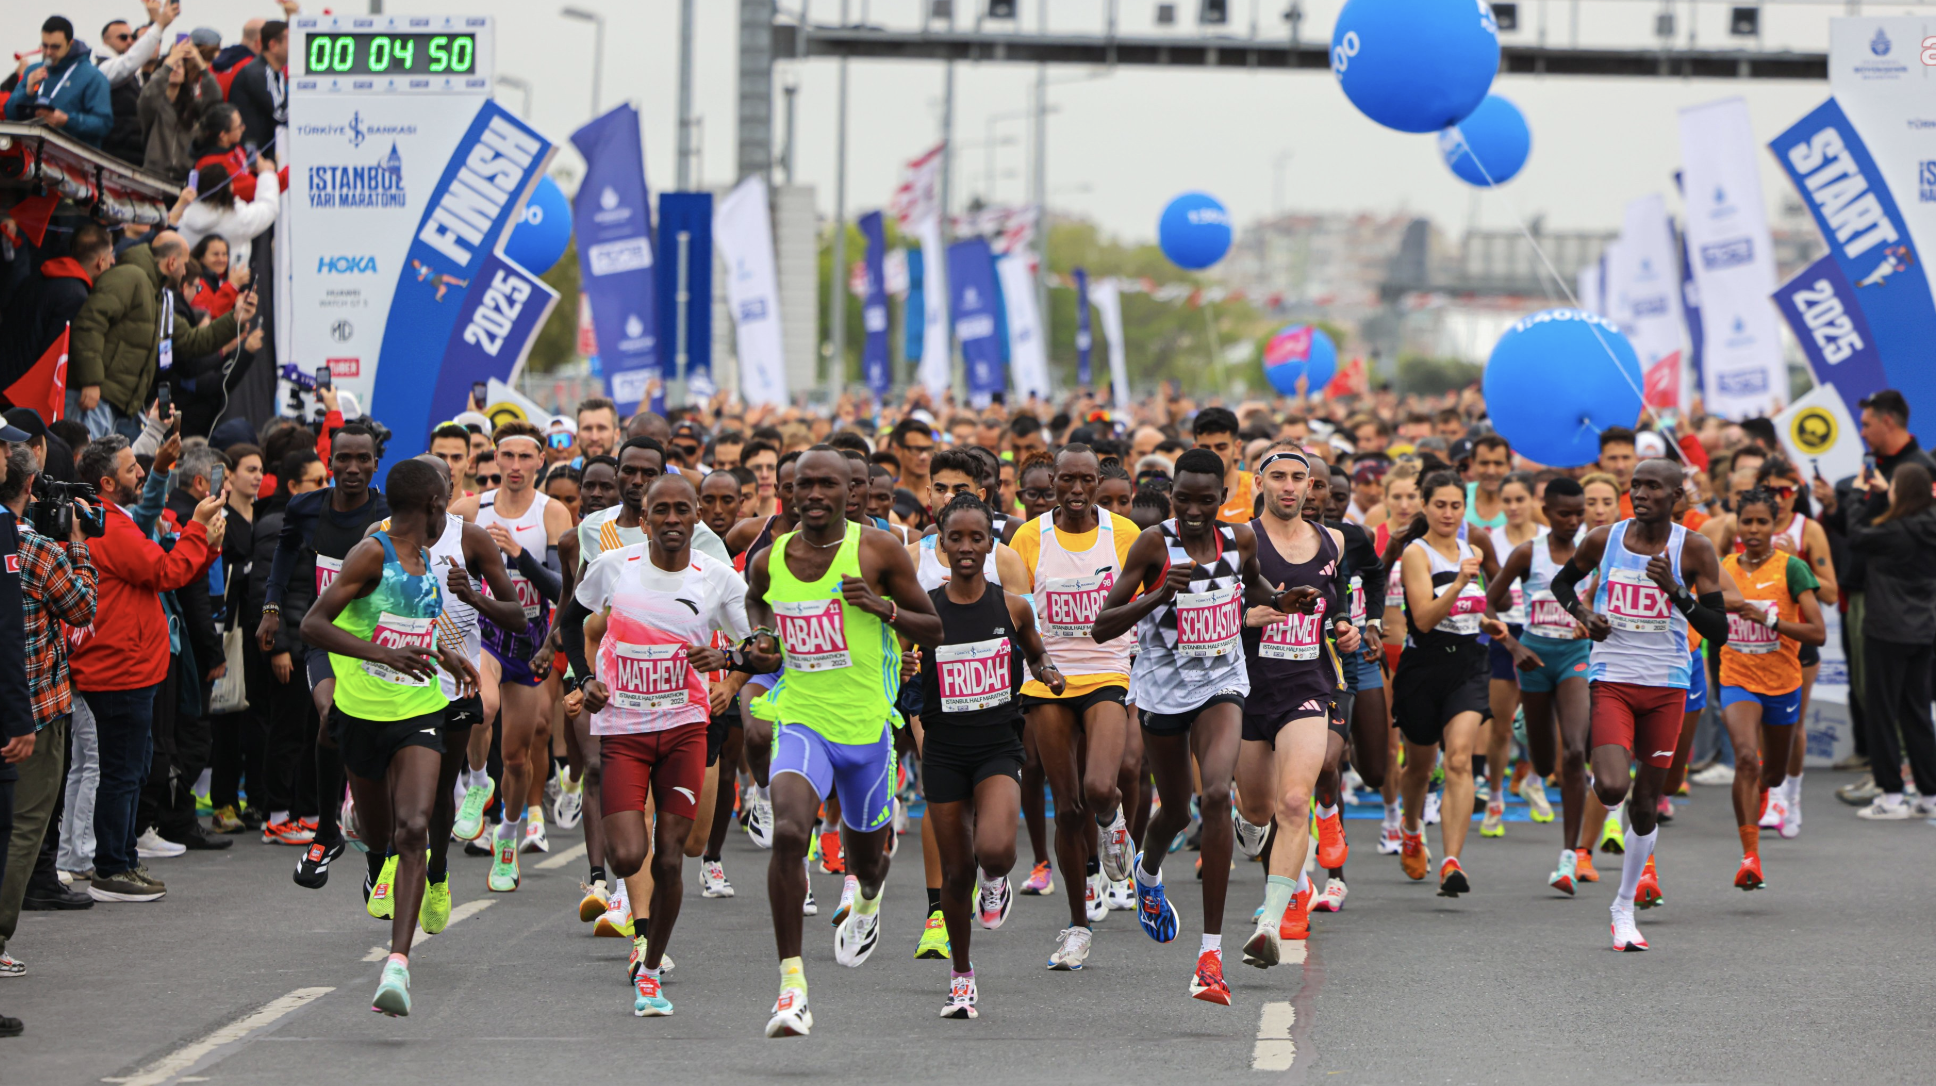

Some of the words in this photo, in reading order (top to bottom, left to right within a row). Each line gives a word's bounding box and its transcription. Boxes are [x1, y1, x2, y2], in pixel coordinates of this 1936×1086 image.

[309, 36, 355, 72] 00
[368, 36, 415, 72] 04
[428, 36, 473, 72] 50
[297, 123, 346, 136] TÜRKİYE
[367, 125, 417, 135] BANKASI
[308, 193, 336, 208] YARI
[339, 193, 406, 208] MARATONU
[418, 114, 542, 268] FINISH
[1787, 126, 1900, 260] START
[317, 256, 378, 274] HOKA
[463, 269, 532, 357] 2025
[1791, 278, 1864, 366] 2025
[1102, 579, 1111, 588] 98
[828, 603, 840, 613] 11
[1608, 583, 1671, 617] ALEX
[776, 615, 845, 653] LABAN
[1181, 600, 1240, 642] SCHOLASTICA
[1262, 612, 1323, 644] AHMET
[677, 649, 687, 658] 10
[831, 659, 847, 667] 2025
[617, 657, 688, 693] MATHEW
[942, 655, 1009, 696] FRIDAH
[619, 692, 643, 701] ISTANBUL
[655, 691, 684, 700] MARATHON
[670, 697, 685, 705] 2025
[945, 697, 970, 705] ISTANBUL
